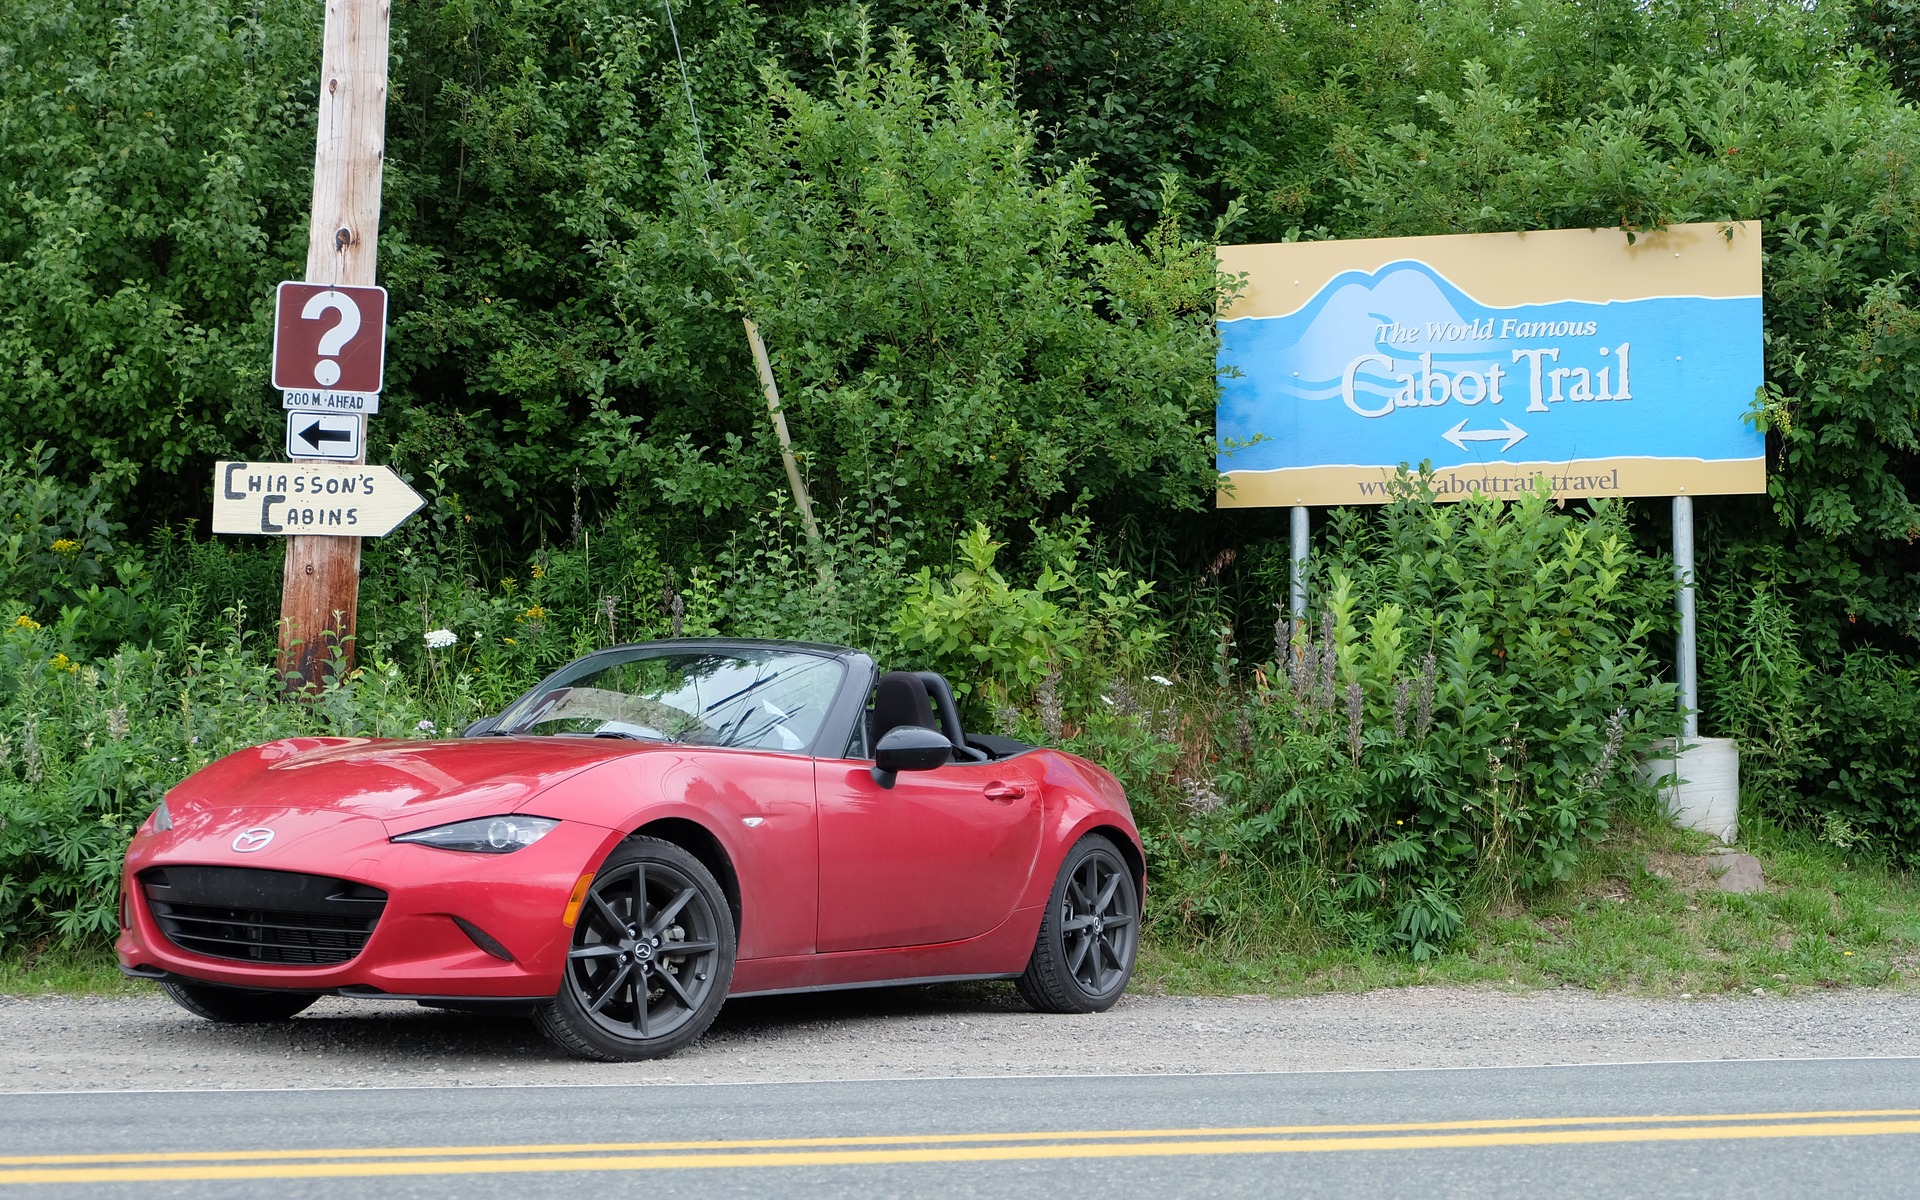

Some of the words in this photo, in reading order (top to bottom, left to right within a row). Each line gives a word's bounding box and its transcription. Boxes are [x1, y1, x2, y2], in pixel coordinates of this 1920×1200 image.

[1376, 321, 1420, 344] The
[1426, 317, 1495, 342] World
[1500, 318, 1598, 339] Famous
[1342, 351, 1506, 418] Cabot
[1512, 342, 1633, 413] Trail
[286, 392, 309, 406] 200
[312, 392, 323, 407] M.
[327, 394, 364, 410] AHEAD
[224, 463, 375, 500] CHIASSON'S
[261, 494, 358, 533] CABINS
